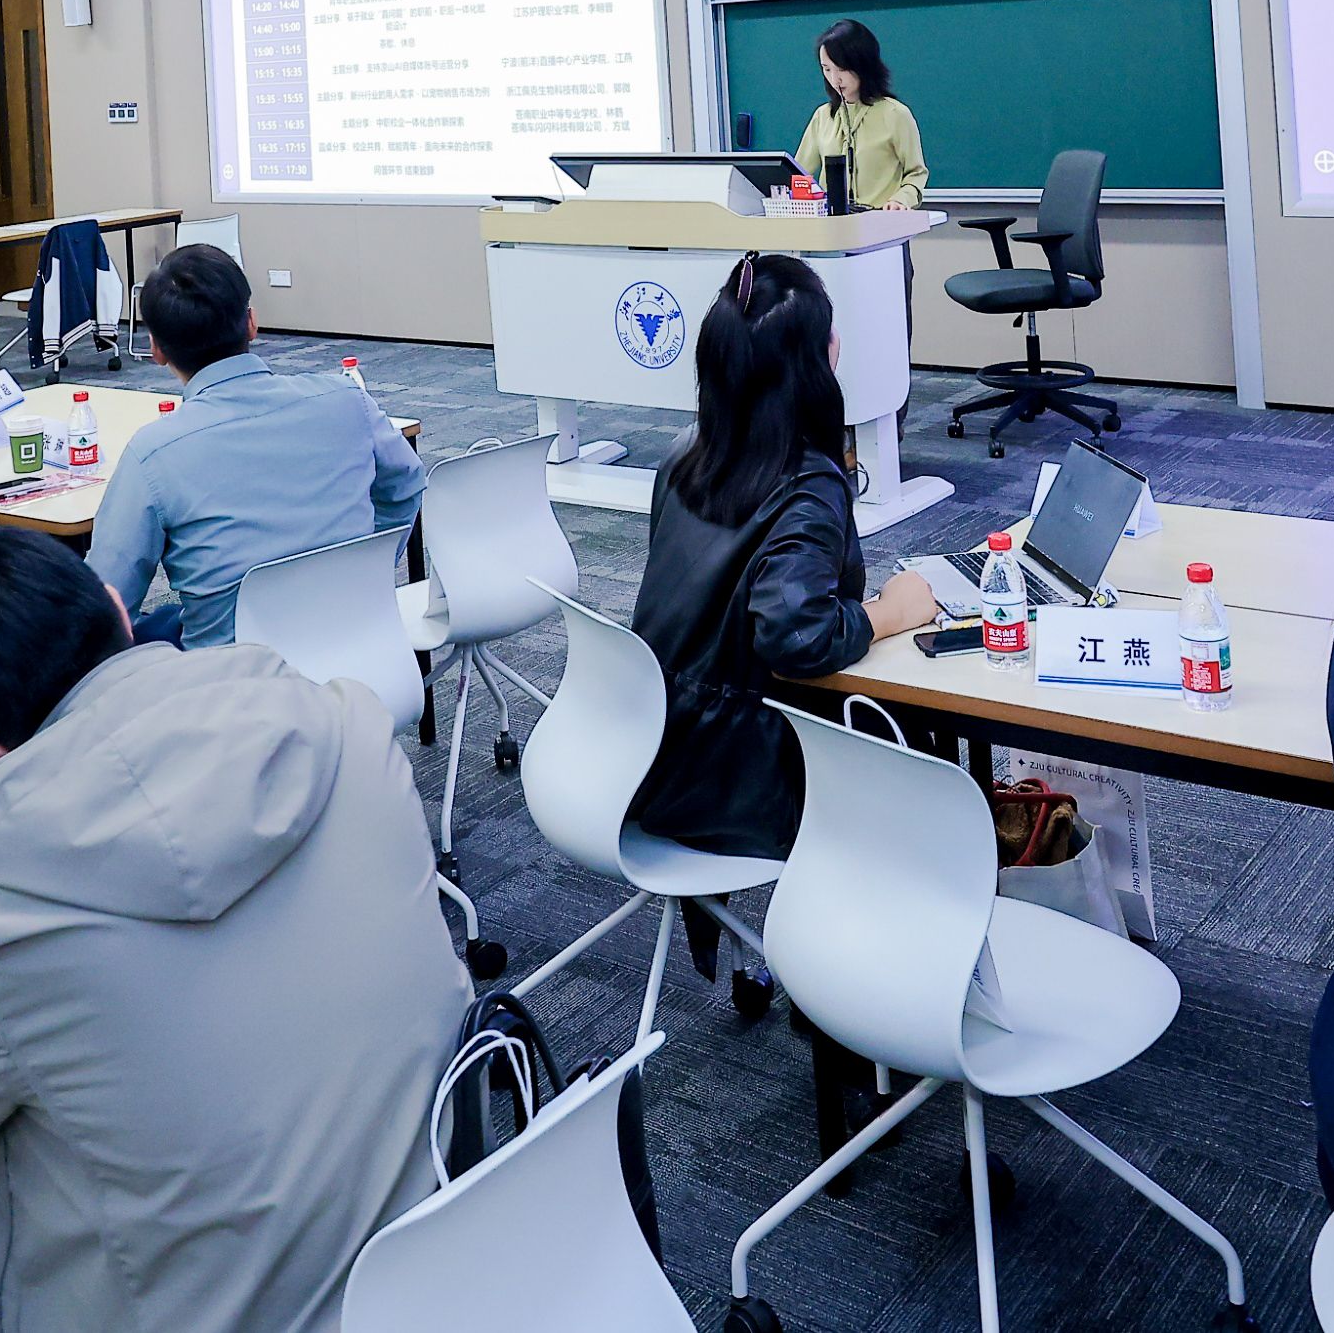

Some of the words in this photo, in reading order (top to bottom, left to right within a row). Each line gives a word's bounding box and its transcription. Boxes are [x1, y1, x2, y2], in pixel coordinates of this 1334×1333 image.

[620, 331, 647, 363] ZHEJIANG
[649, 334, 682, 365] UNIVERSITY
[1073, 500, 1095, 523] HUAWEI
[1029, 761, 1045, 771] ZJU
[1046, 764, 1088, 780] CULTURAL
[1089, 773, 1134, 806] CREATIVITY
[1128, 826, 1141, 873] CULTURAL
